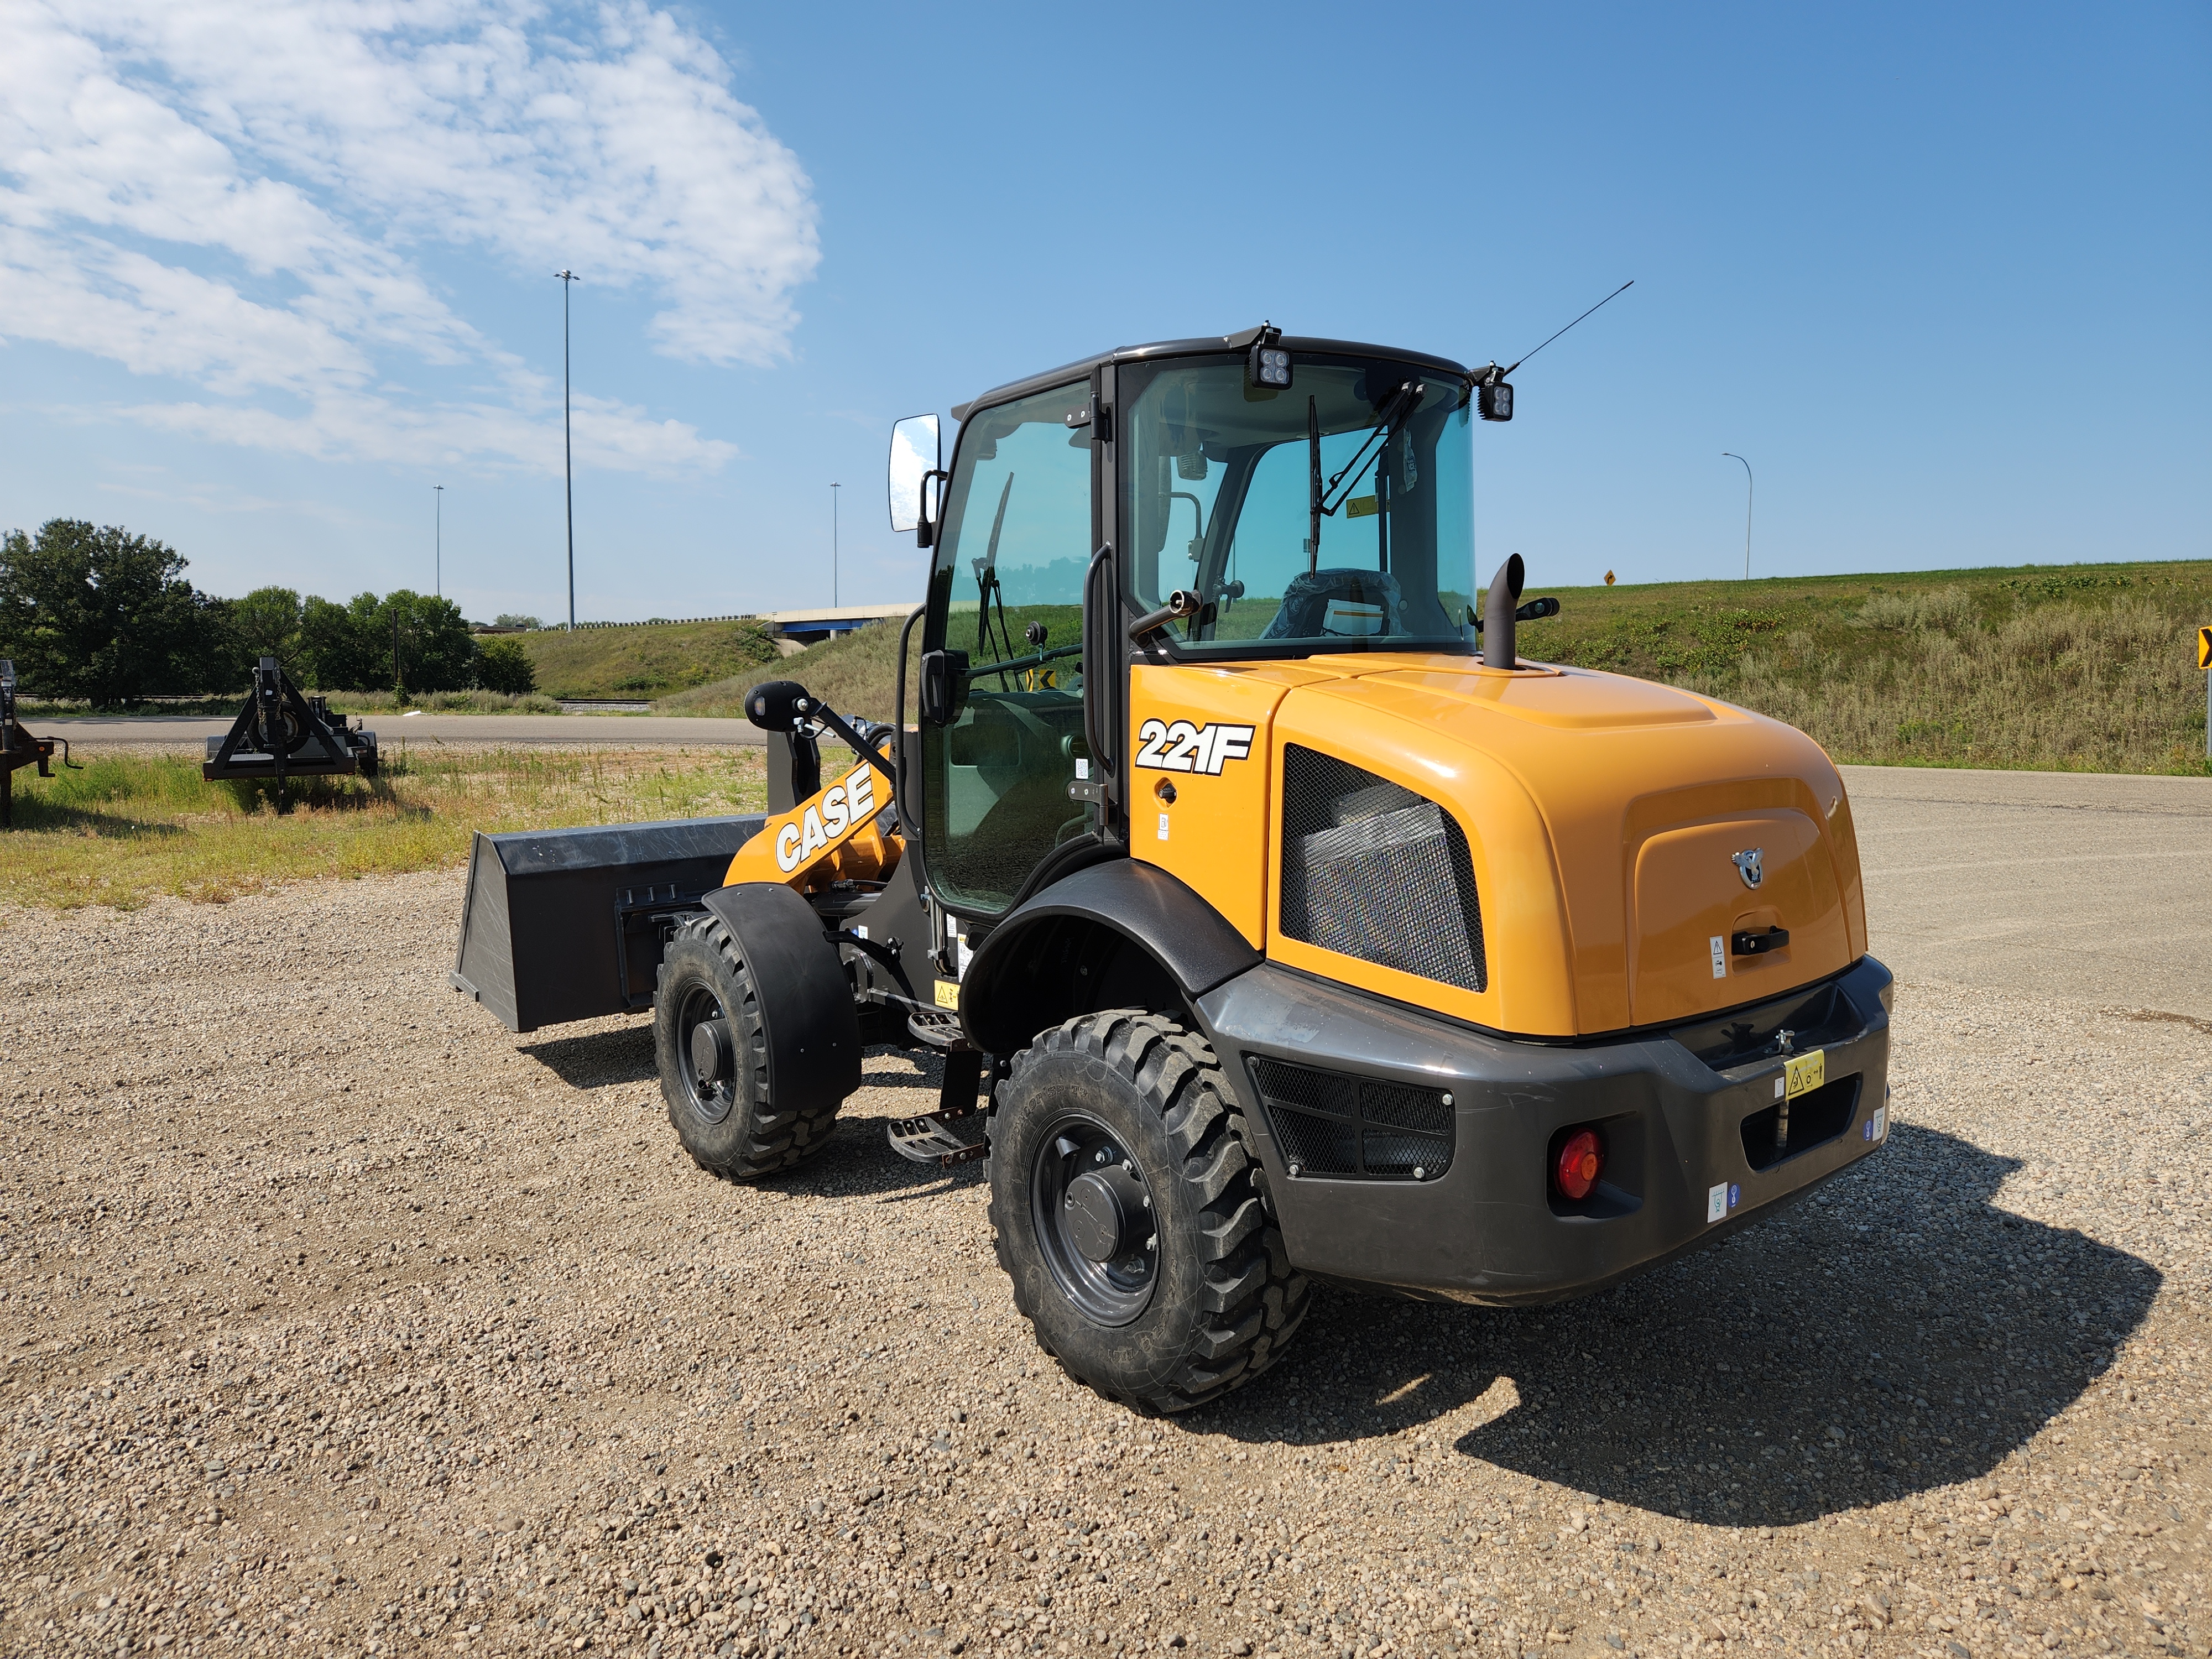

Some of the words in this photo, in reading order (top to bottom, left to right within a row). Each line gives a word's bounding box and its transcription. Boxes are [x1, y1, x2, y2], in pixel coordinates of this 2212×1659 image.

[1135, 718, 1256, 776] 221F
[776, 762, 875, 873] CASE
[1010, 1092, 1042, 1149] DUNLOP
[1047, 1084, 1065, 1098] SP
[1071, 1085, 1088, 1097] T9
